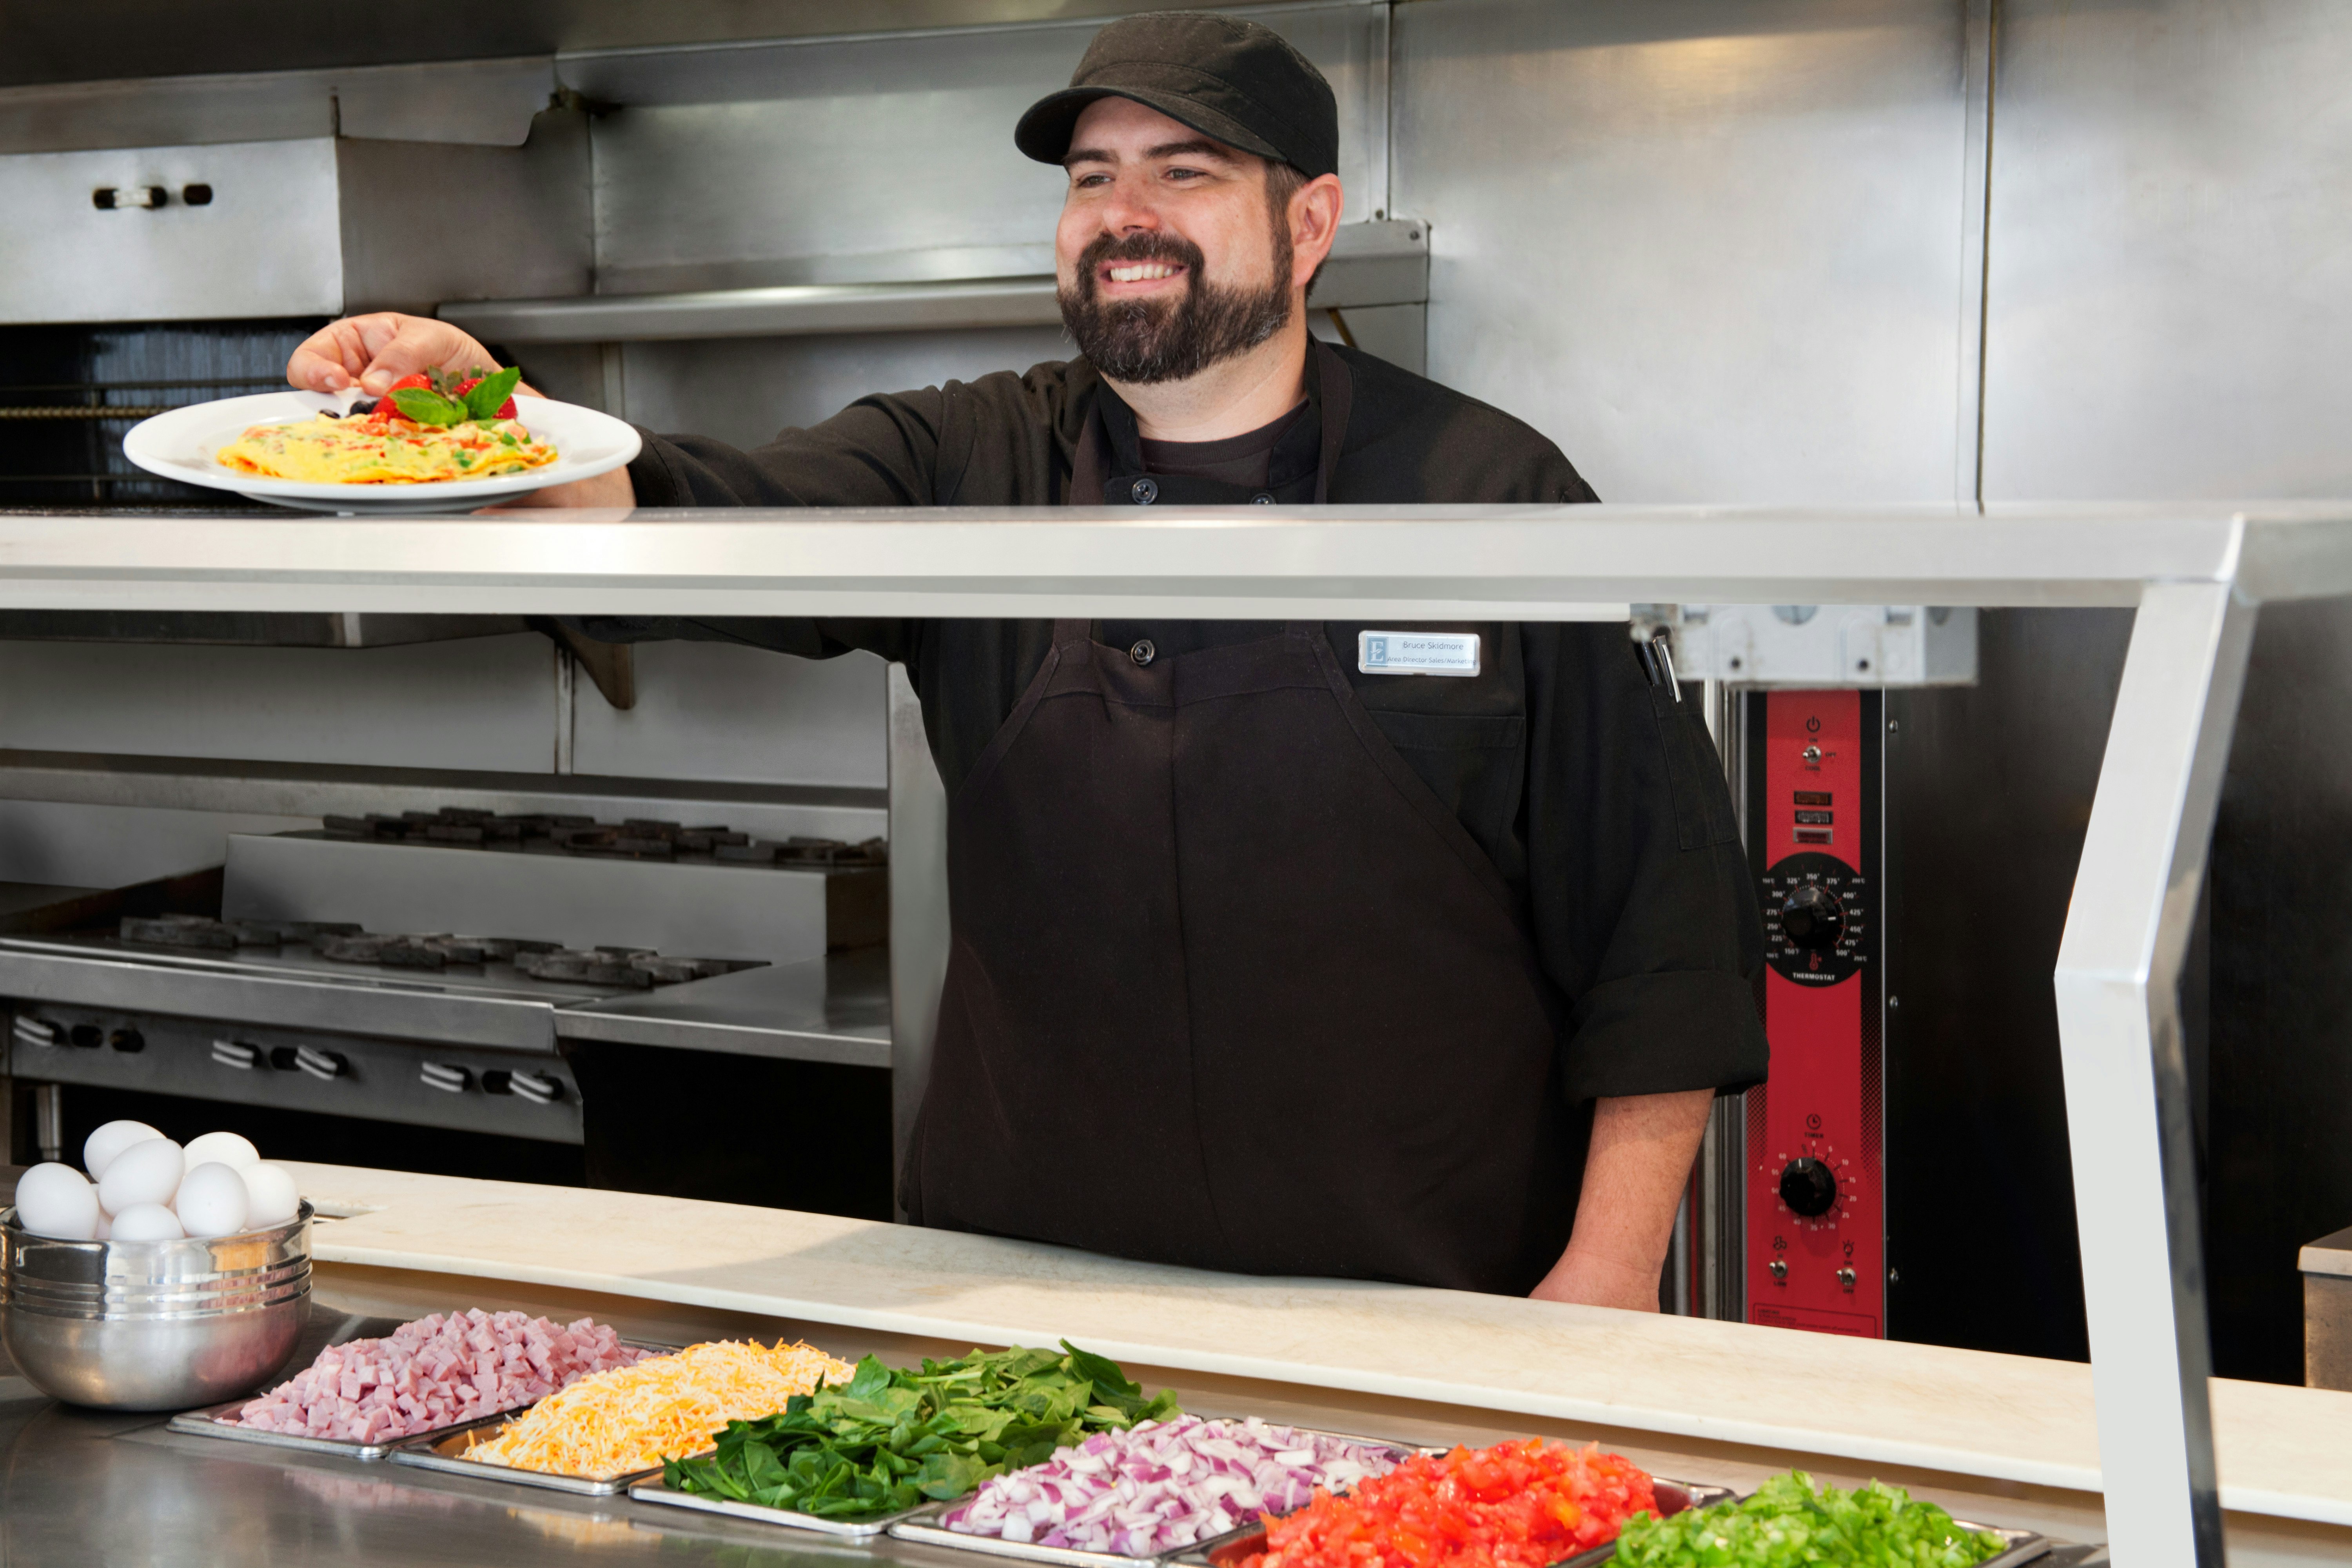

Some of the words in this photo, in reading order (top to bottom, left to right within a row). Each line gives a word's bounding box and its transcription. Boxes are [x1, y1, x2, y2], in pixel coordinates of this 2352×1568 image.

[1428, 642, 1464, 650] Skidmore
[1370, 641, 1384, 661] E
[1793, 972, 1835, 981] THERMOSTAT
